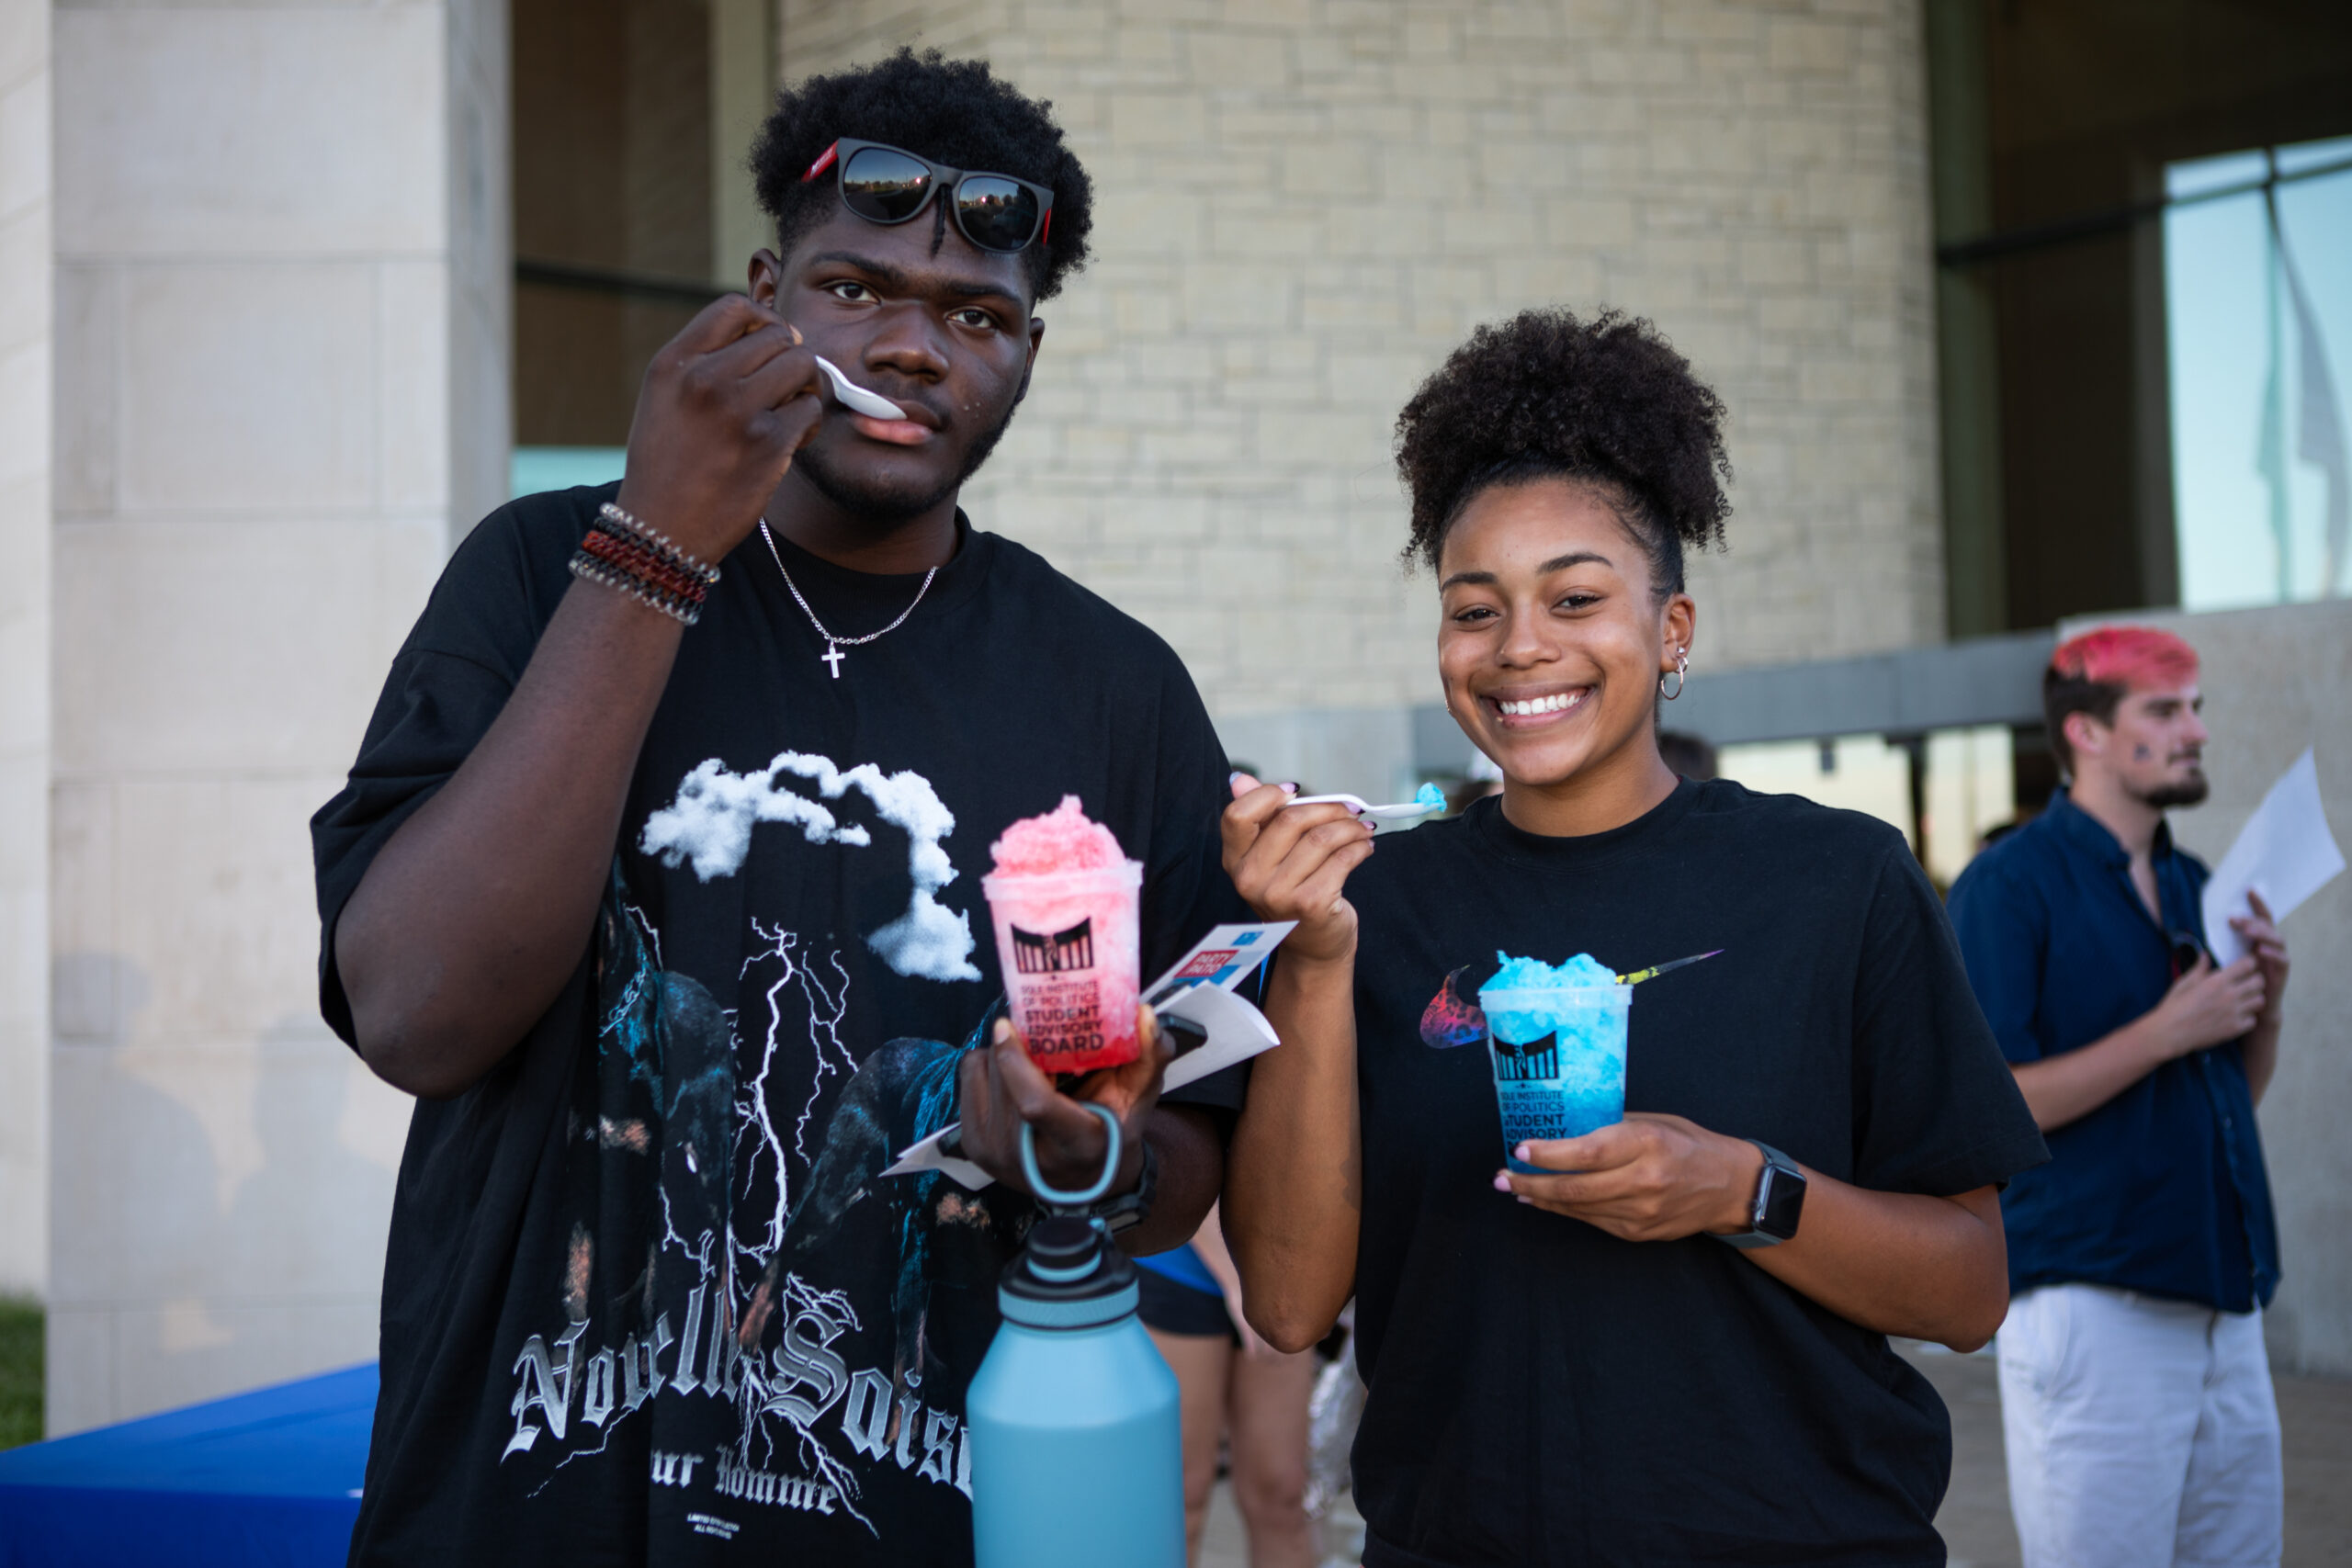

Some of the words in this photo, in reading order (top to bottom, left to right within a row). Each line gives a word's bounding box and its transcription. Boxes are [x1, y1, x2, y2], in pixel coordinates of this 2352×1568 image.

[1046, 980, 1099, 993] INSTITUTE
[1041, 993, 1101, 1007] POLITICS
[1025, 1005, 1099, 1022] STUDENT
[1028, 1020, 1102, 1036] ADVISORY
[1030, 1034, 1104, 1055] BOARD
[1517, 1090, 1564, 1101] INSTITUTE
[1513, 1101, 1566, 1113] POLITICS
[1507, 1127, 1567, 1140] ADVISORY
